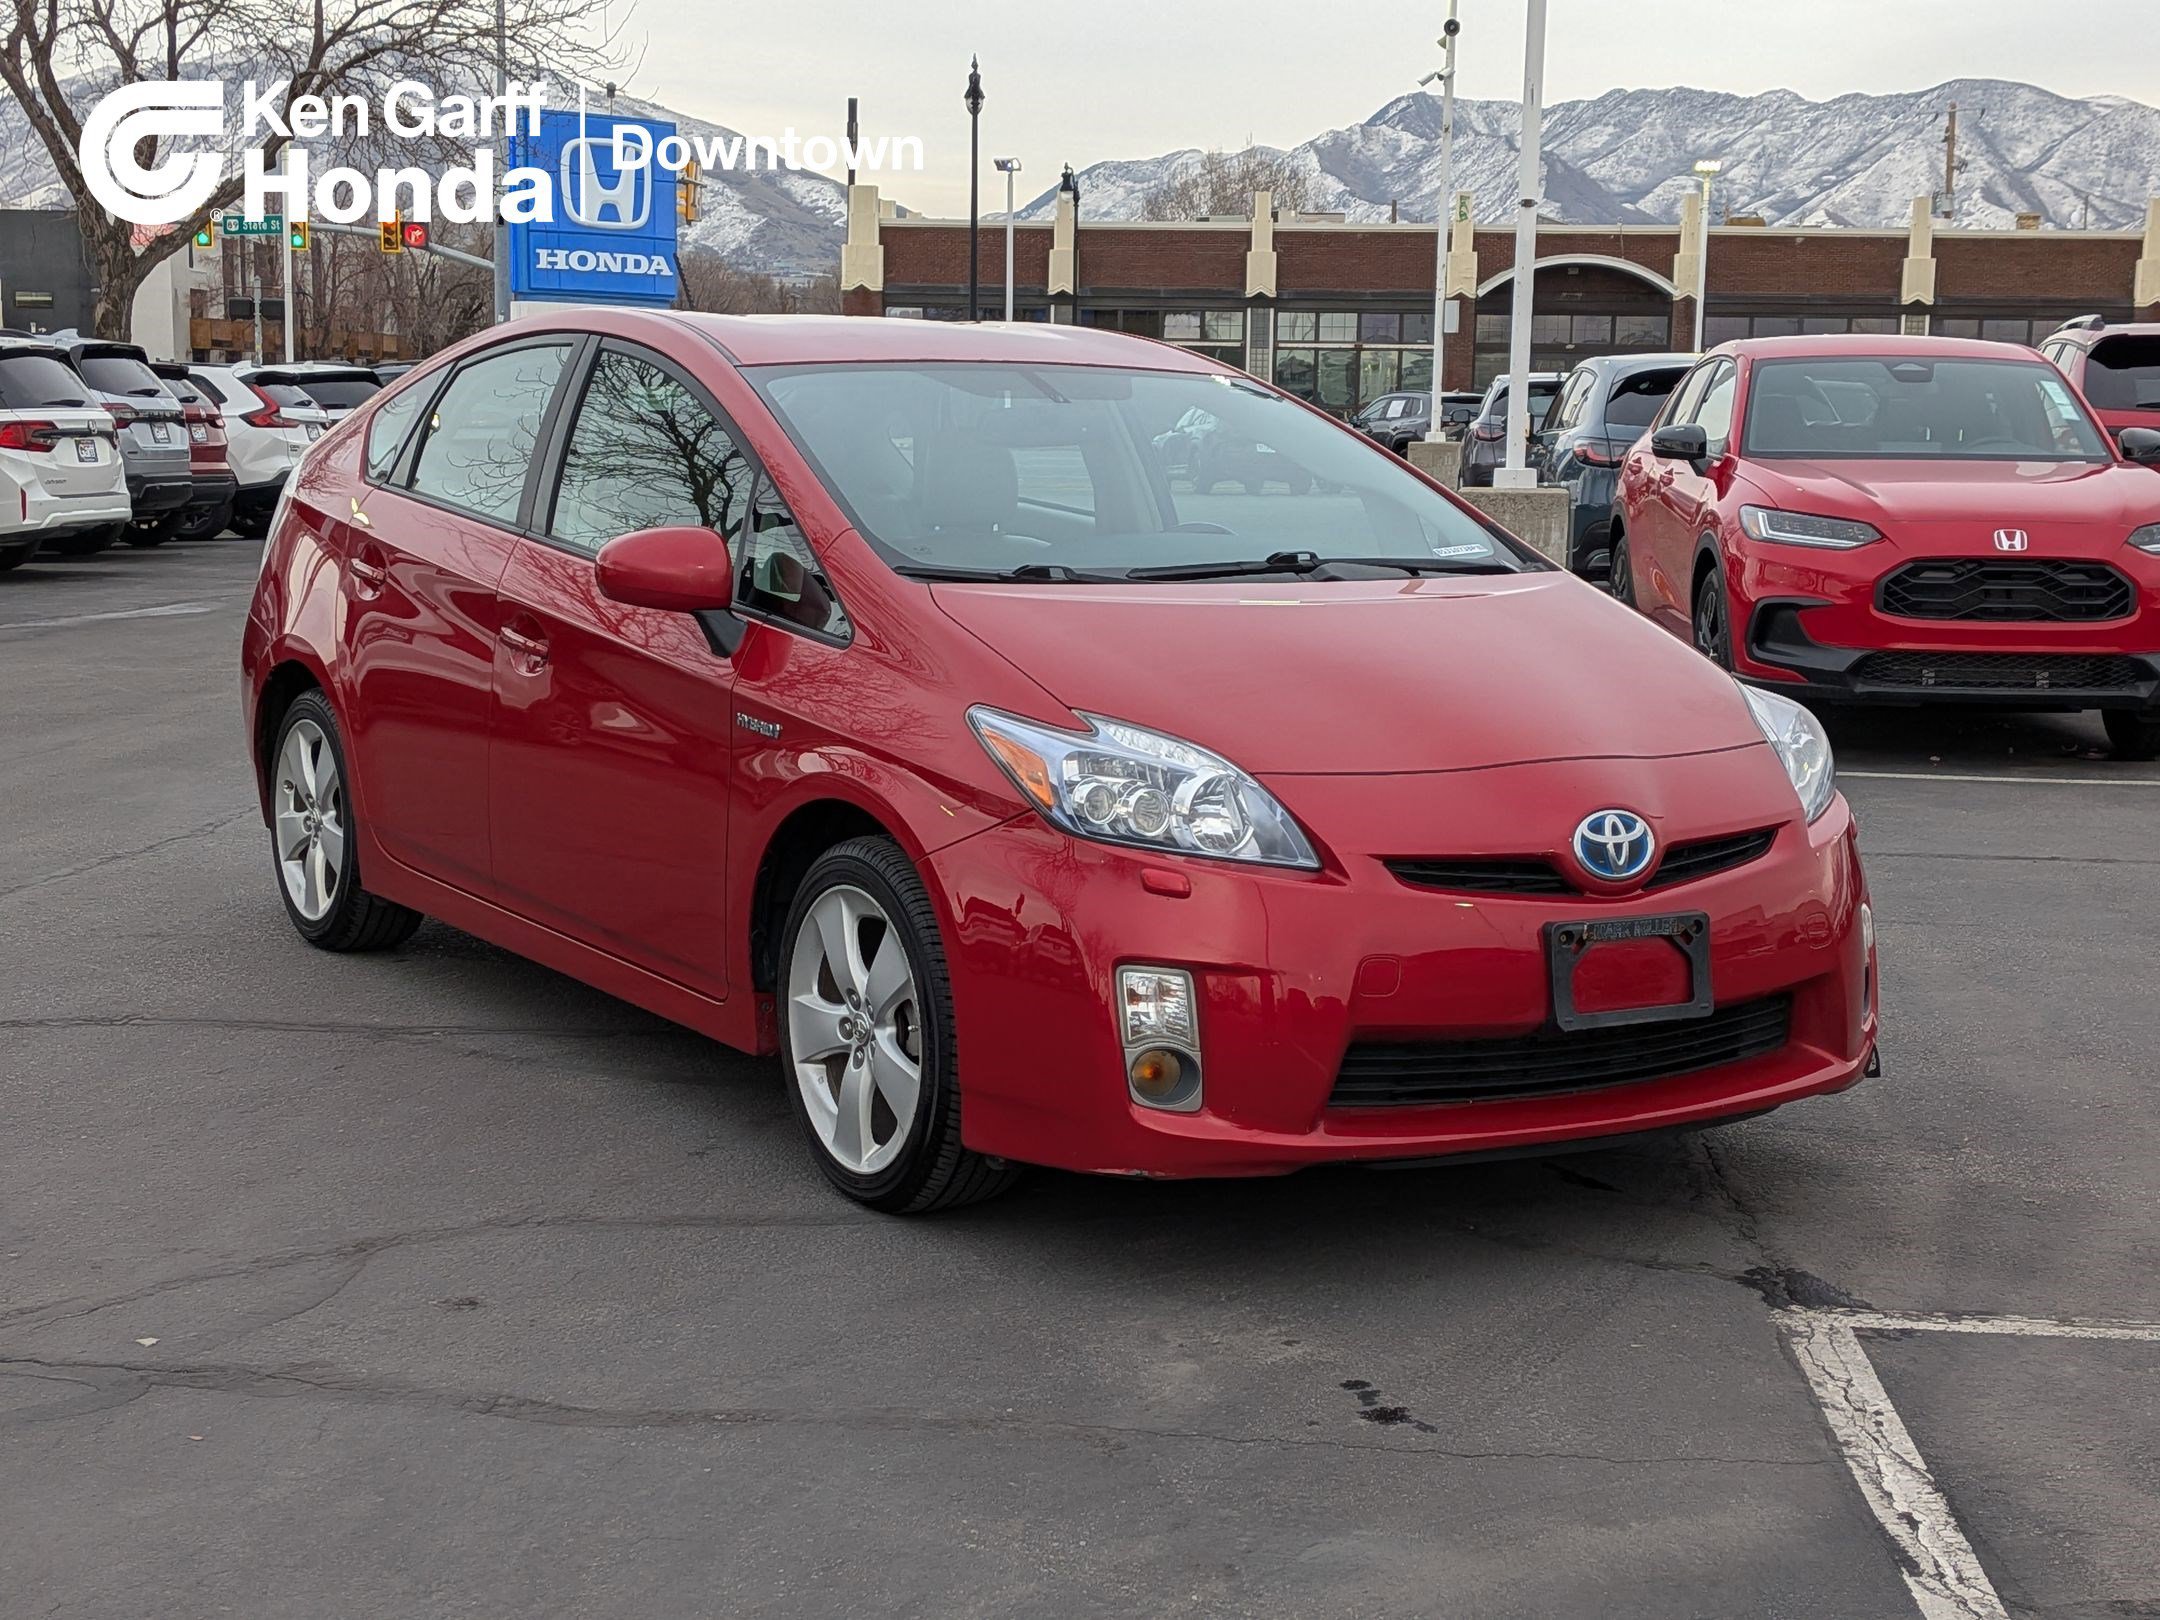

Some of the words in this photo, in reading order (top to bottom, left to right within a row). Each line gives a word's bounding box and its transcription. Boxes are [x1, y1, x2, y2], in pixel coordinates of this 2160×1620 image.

[243, 221, 267, 231] State
[271, 220, 281, 230] St
[535, 248, 673, 276] HONDA
